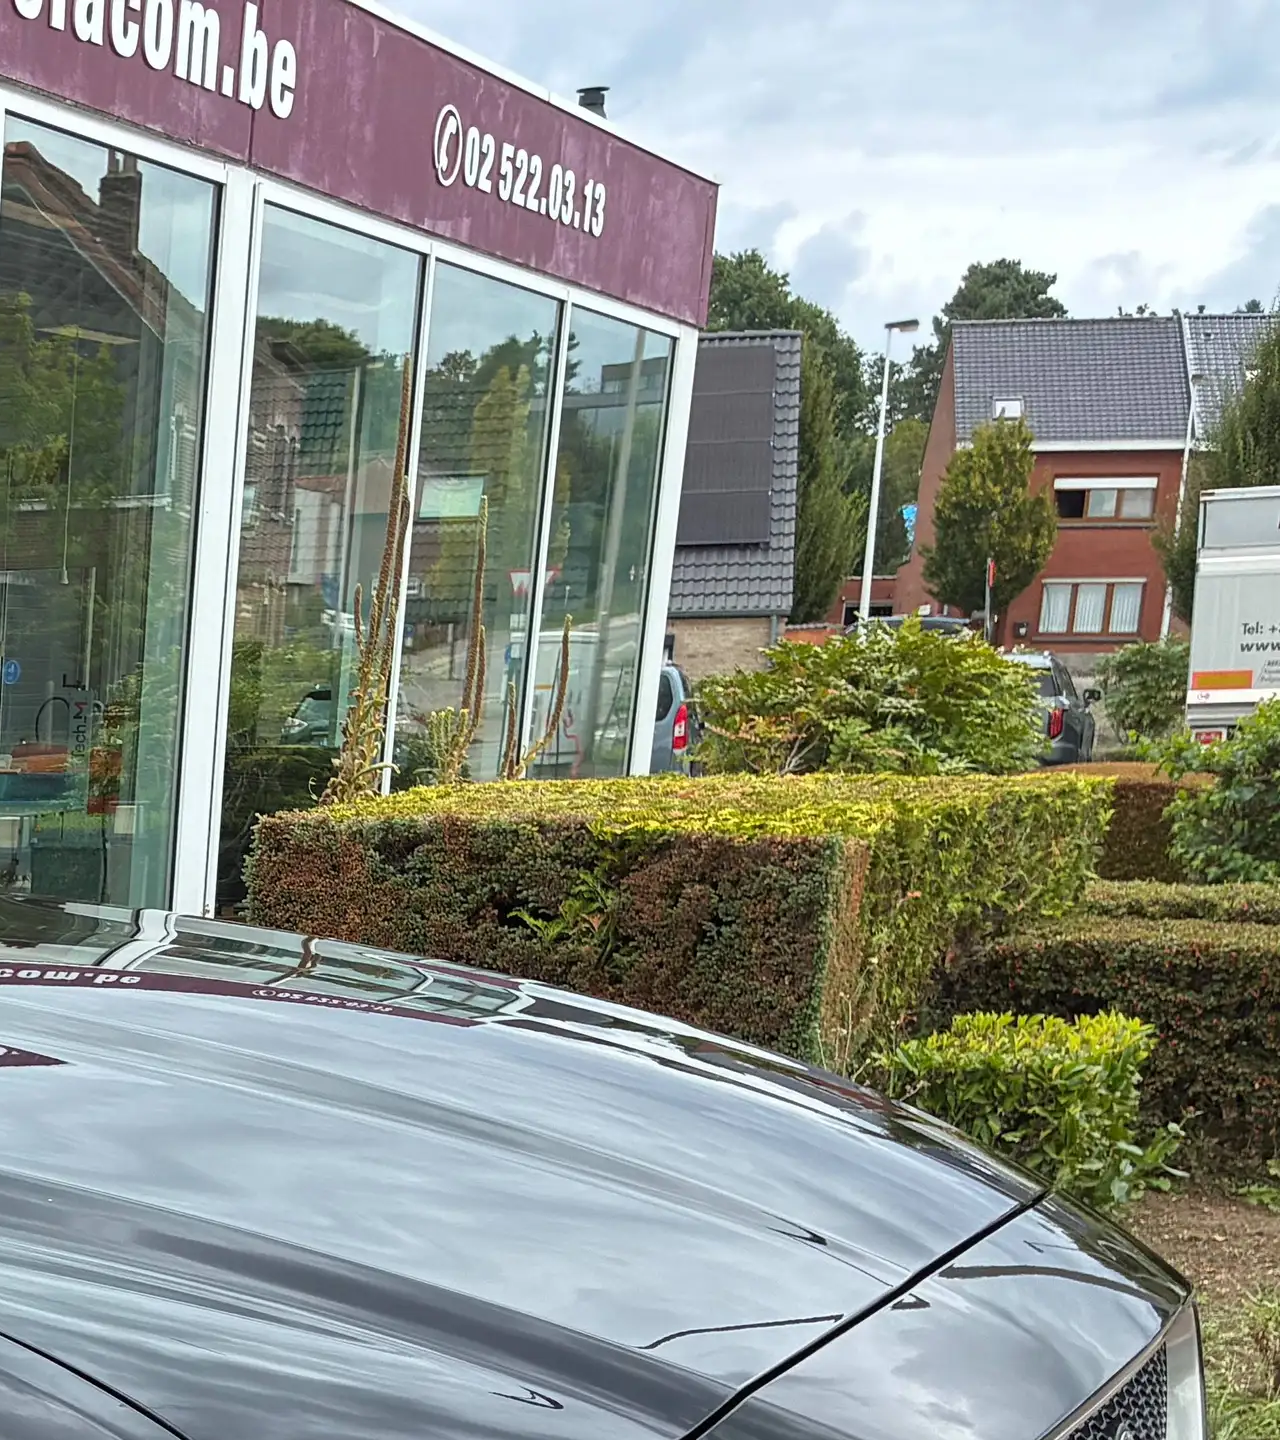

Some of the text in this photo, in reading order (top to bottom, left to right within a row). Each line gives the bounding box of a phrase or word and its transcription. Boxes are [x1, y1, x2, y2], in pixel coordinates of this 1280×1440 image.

[463, 126, 607, 238] 02 522.03.13
[1241, 621, 1264, 636] Tel:
